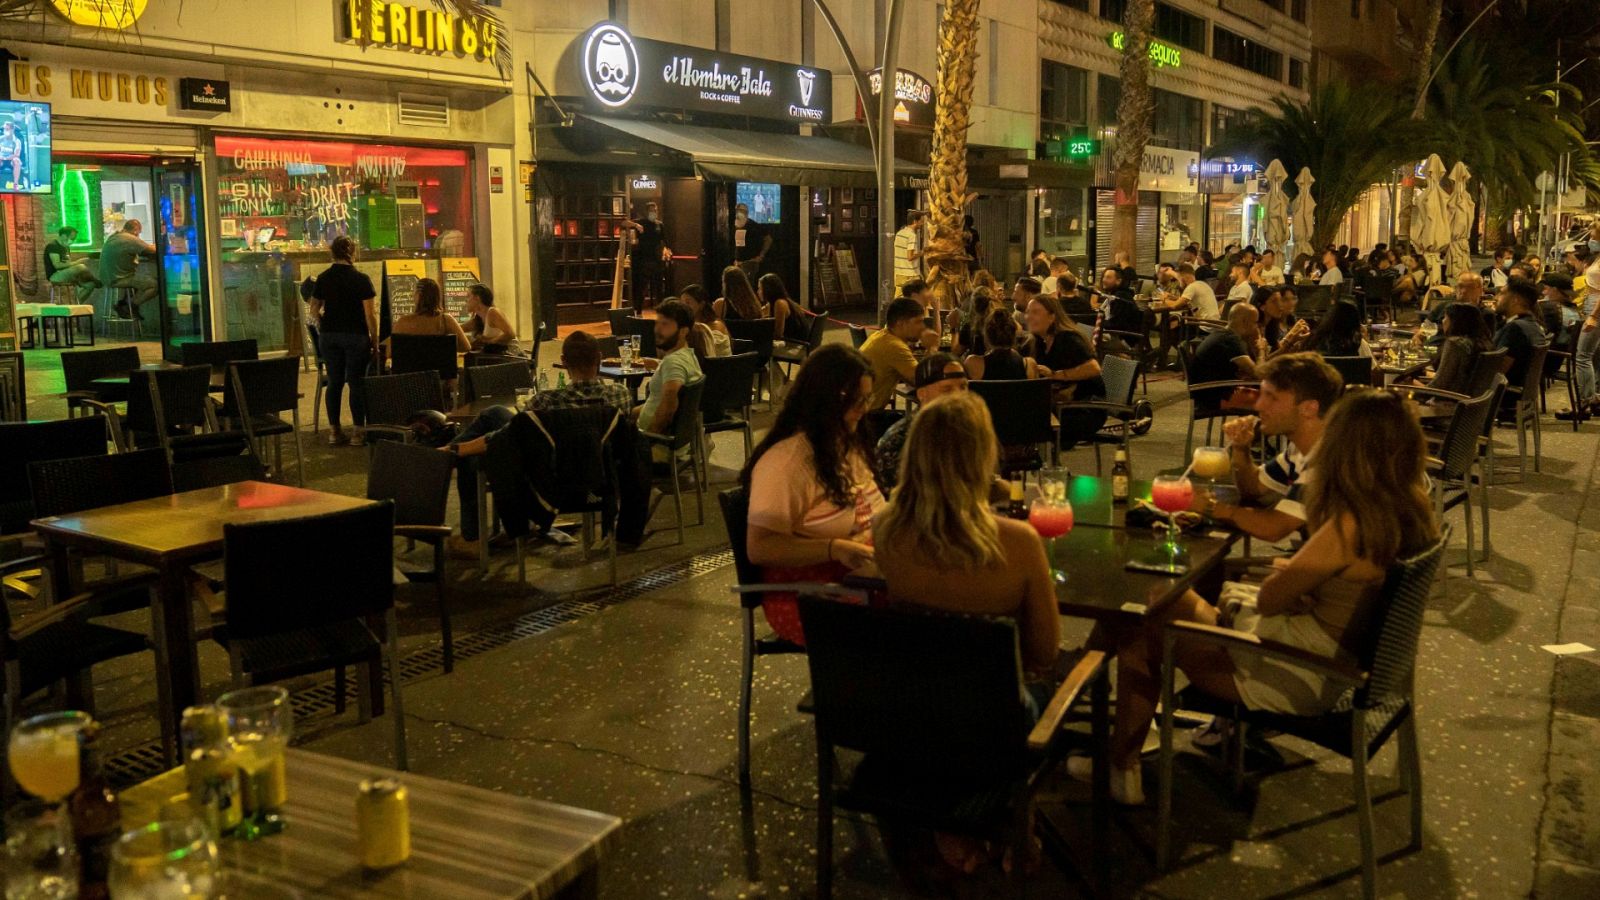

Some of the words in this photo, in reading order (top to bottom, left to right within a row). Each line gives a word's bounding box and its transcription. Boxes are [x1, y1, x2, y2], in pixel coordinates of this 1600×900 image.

[1149, 41, 1180, 68] seguros
[663, 56, 679, 83] el
[680, 57, 741, 92] Hombre
[70, 68, 168, 106] MUROS
[700, 91, 717, 101] ROCK
[721, 93, 741, 104] COFFEE
[869, 71, 931, 104] BRBAS
[192, 94, 227, 105] Heineken
[789, 104, 823, 120] GUINNESS
[232, 182, 273, 198] GIN
[311, 182, 353, 208] DRAFT
[318, 202, 351, 224] BEER
